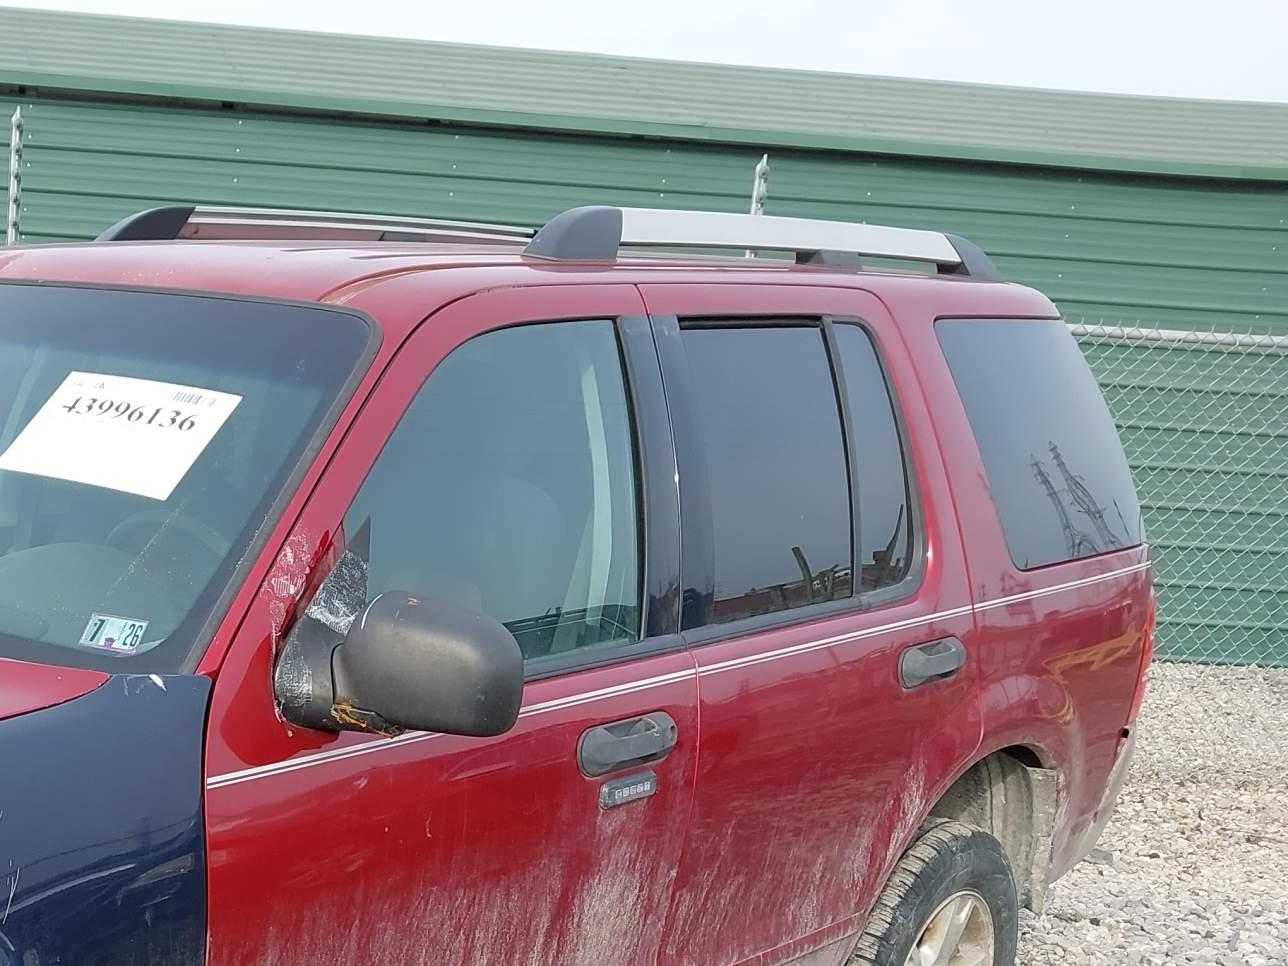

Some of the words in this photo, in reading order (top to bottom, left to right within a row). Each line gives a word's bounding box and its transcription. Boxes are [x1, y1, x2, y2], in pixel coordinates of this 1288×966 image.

[62, 396, 201, 431] 43996136
[89, 618, 106, 642] 7
[122, 623, 144, 647] 26
